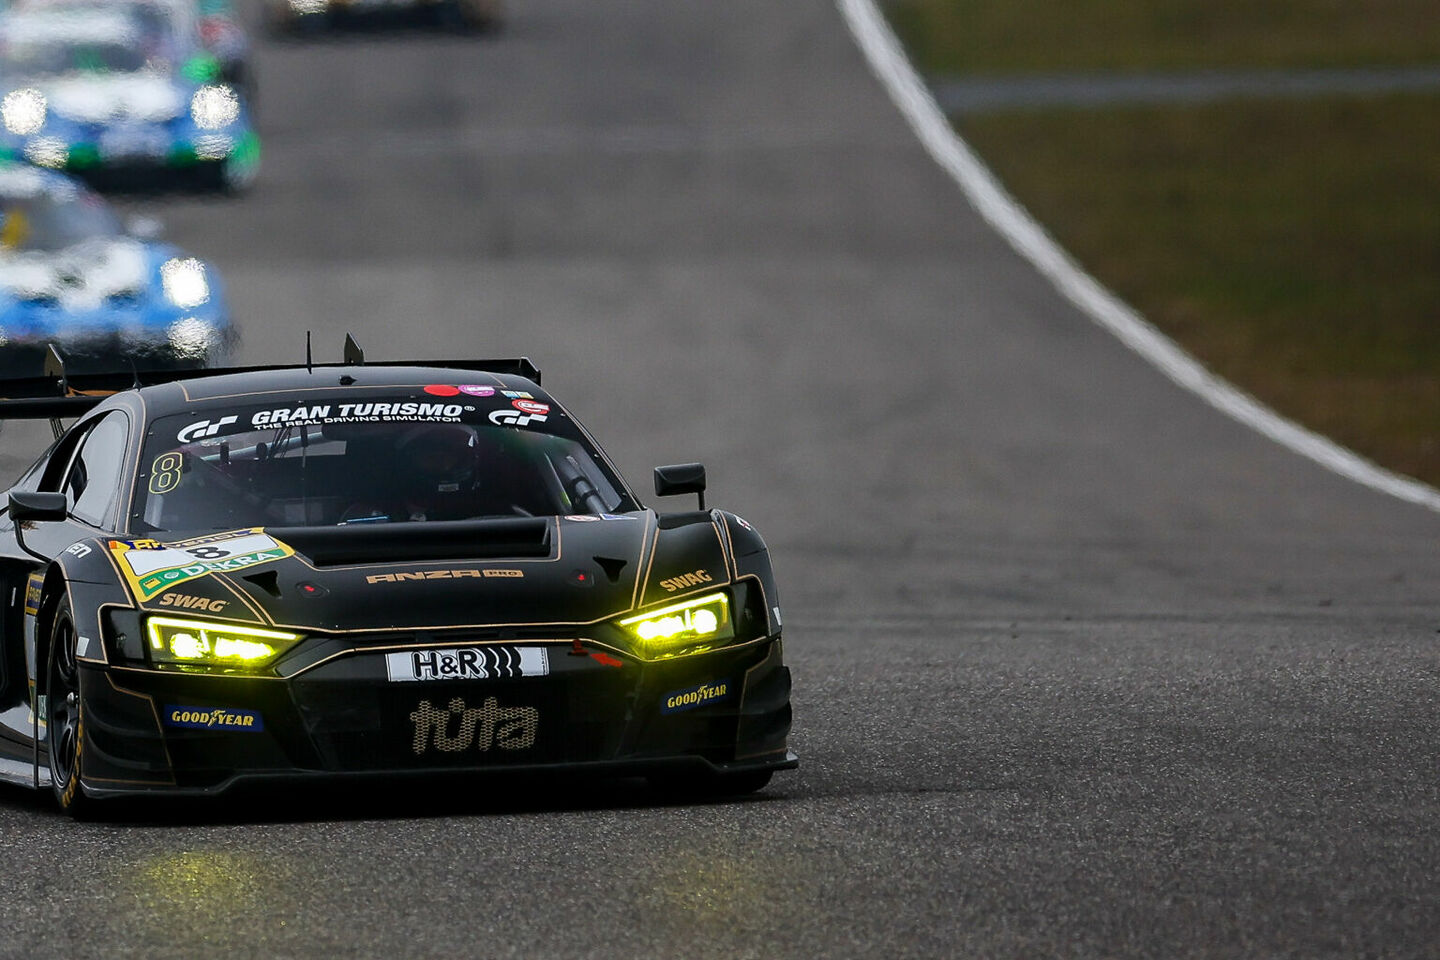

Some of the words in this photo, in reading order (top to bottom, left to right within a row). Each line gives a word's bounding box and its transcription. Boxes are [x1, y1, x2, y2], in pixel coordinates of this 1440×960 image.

[251, 405, 331, 426] GRAN
[253, 422, 283, 431] THE
[286, 419, 321, 428] REAL
[324, 416, 379, 424] DRIVING
[382, 415, 462, 424] SIMULATOR
[148, 452, 183, 494] 8
[185, 546, 231, 560] 8
[180, 551, 279, 577] DEKRA
[366, 569, 482, 584] ANZA
[660, 569, 713, 592] SWAG
[159, 592, 228, 613] SWAG
[411, 648, 486, 680] H&R
